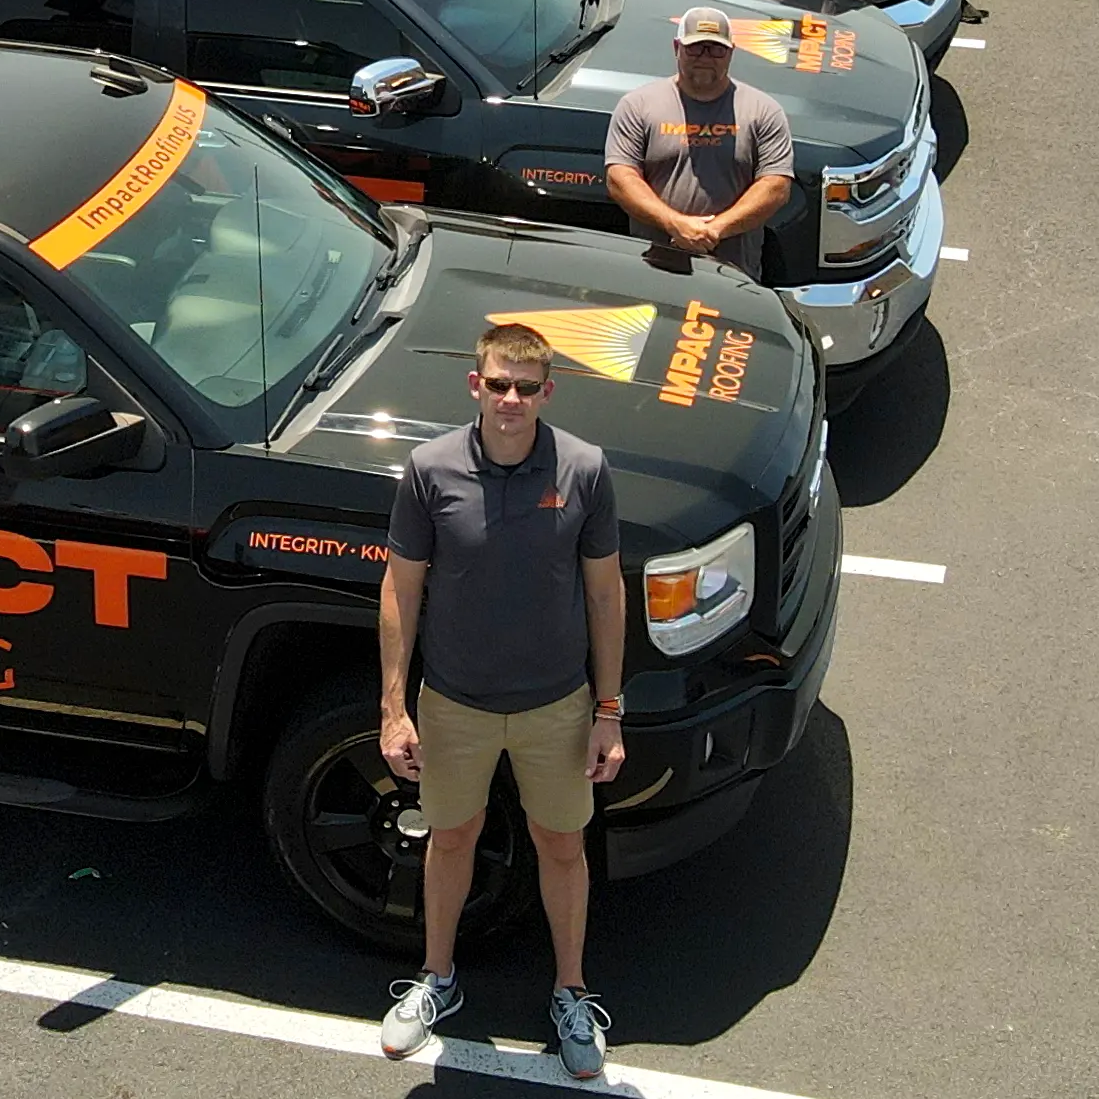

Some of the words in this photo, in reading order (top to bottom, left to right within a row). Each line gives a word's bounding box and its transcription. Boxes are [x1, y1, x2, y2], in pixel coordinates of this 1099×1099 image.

[660, 122, 740, 136] IMPACT
[77, 104, 197, 230] ImpactRoofing.US
[522, 167, 596, 186] INTEGRITY
[658, 300, 721, 407] IMPACT
[249, 531, 348, 556] INTEGRITY
[360, 544, 388, 562] KN
